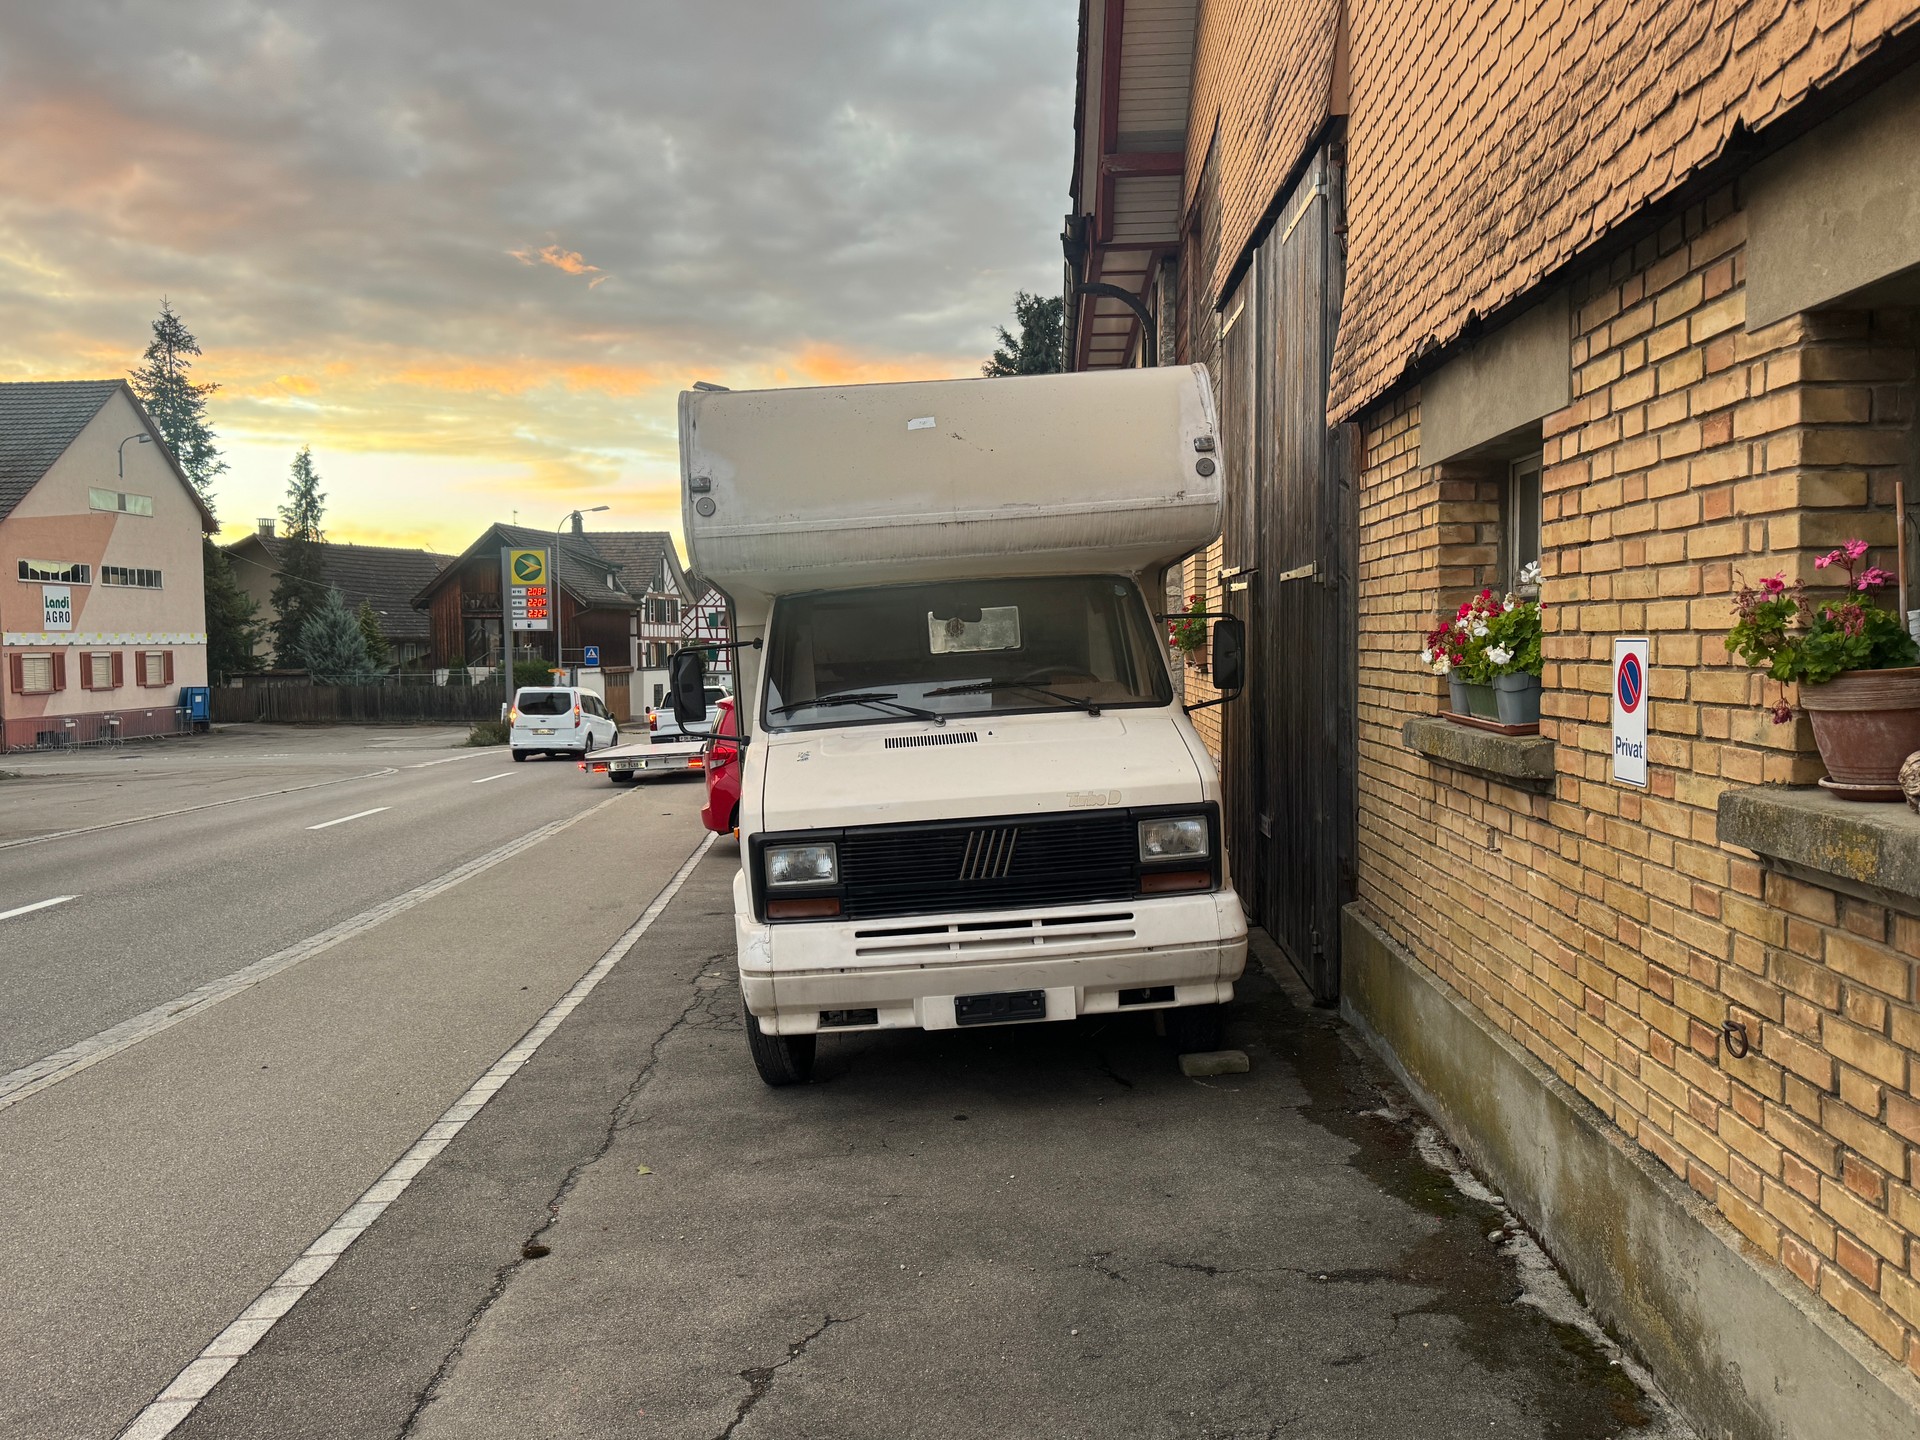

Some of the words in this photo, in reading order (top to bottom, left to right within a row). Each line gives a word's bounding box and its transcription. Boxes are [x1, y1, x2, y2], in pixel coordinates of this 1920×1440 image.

[45, 595, 69, 608] Landi
[45, 610, 70, 623] AGRO
[1615, 735, 1642, 759] Privat
[1066, 791, 1107, 807] Turbo
[1108, 789, 1122, 805] D
